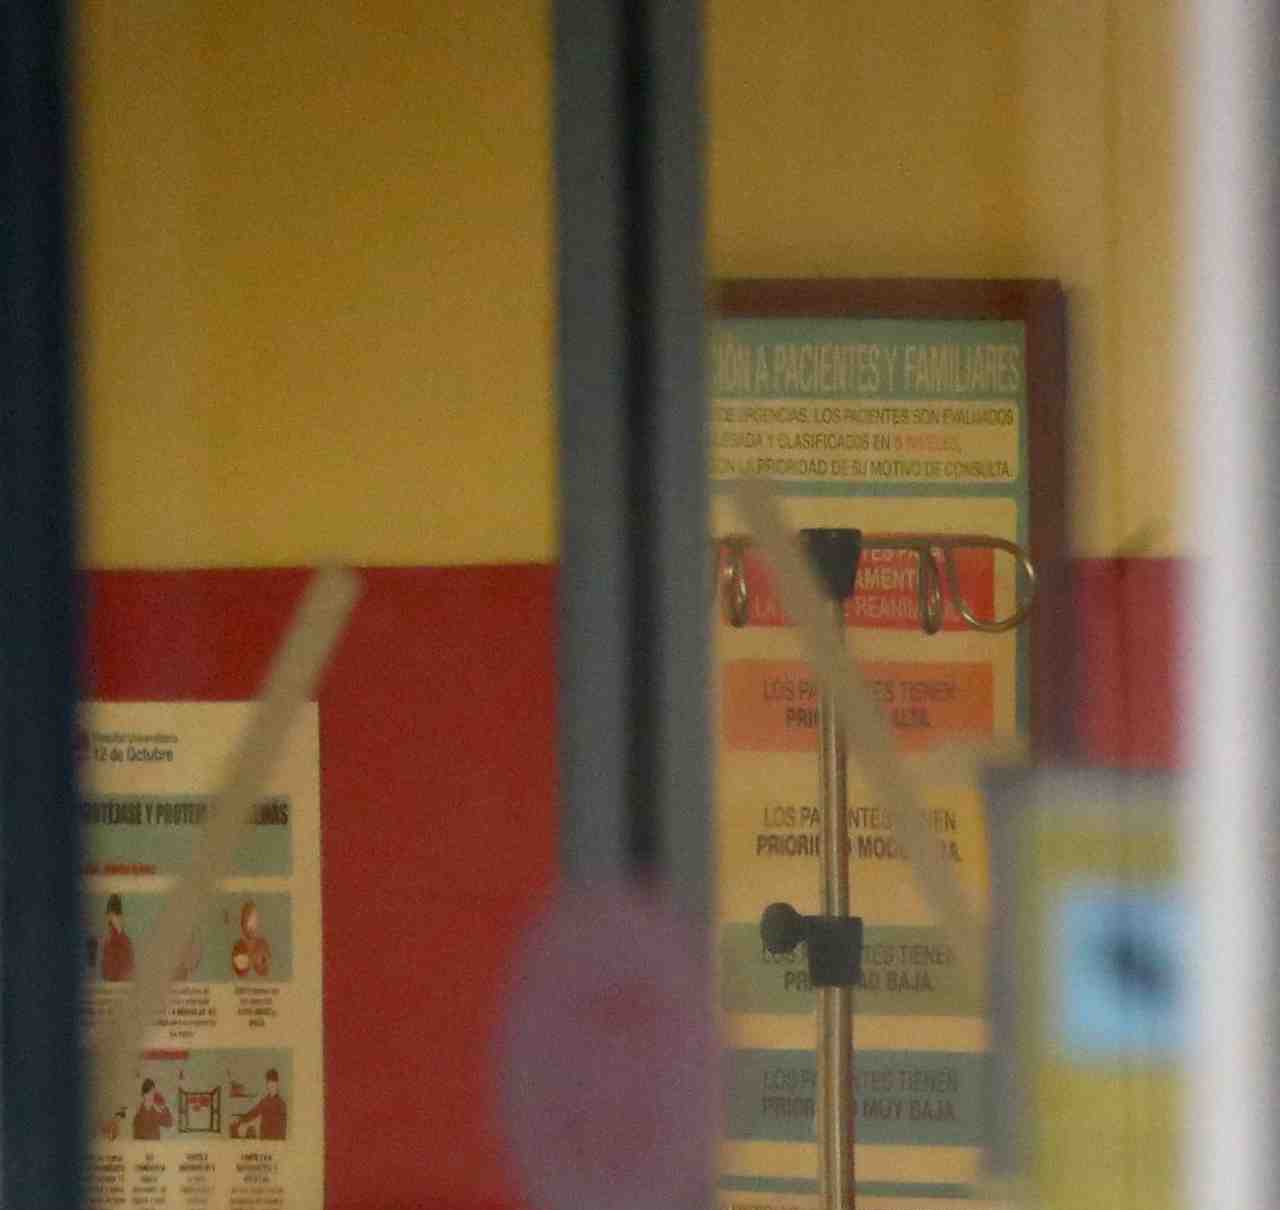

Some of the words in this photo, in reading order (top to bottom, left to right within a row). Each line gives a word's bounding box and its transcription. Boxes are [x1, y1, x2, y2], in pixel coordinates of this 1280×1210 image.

[773, 344, 881, 393] PACIENTES
[885, 345, 899, 393] Y
[904, 344, 1020, 393] FAMILIARES
[813, 408, 840, 423] LOS
[127, 747, 174, 762] Octubre
[764, 805, 797, 829] LOS
